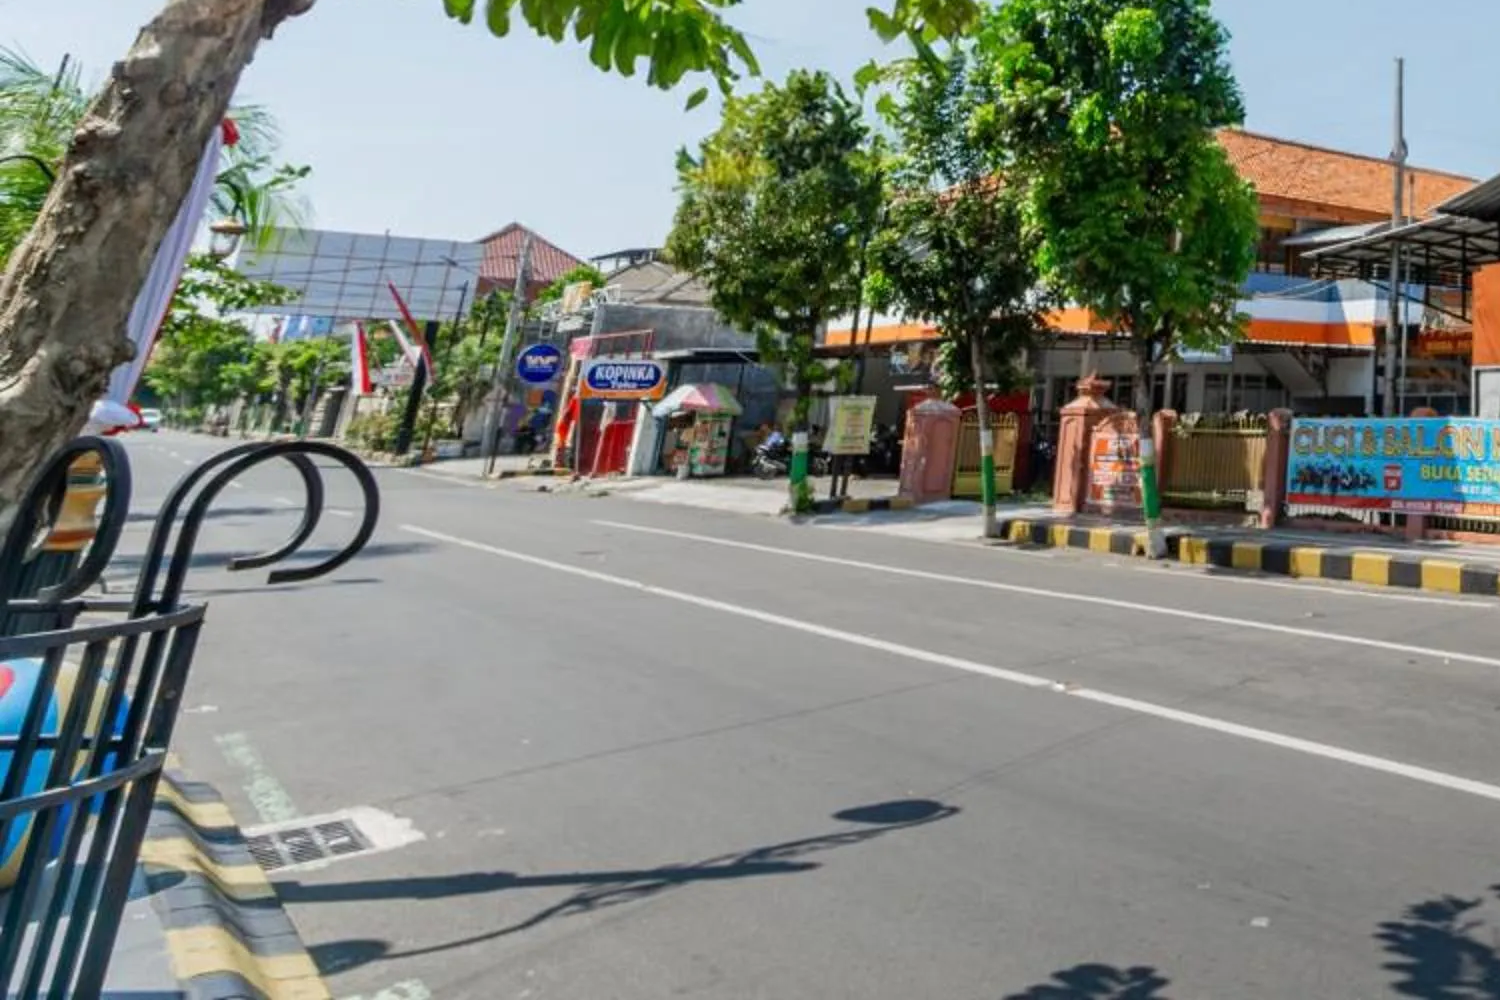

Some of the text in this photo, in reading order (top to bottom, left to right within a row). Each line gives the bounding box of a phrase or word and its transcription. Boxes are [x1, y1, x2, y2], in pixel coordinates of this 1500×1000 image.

[595, 365, 655, 381] KOPINKA
[1294, 425, 1355, 456] CUCI
[1383, 425, 1485, 461] SALON
